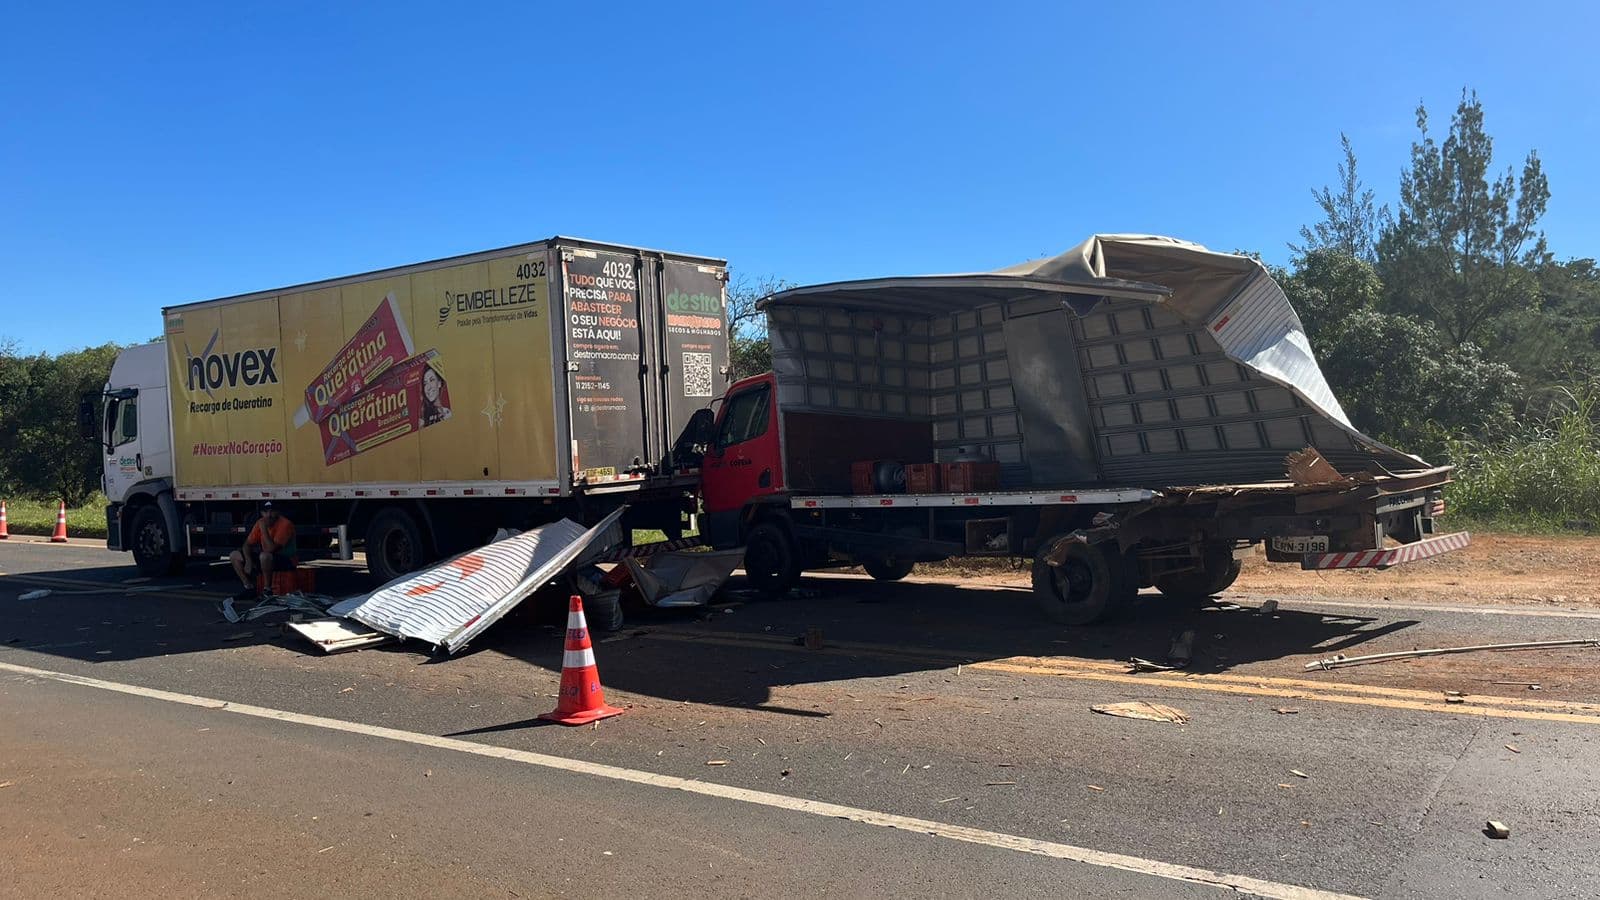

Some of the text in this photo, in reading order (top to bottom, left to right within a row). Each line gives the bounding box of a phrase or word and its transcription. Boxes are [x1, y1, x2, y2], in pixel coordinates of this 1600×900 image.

[516, 261, 546, 280] 4032
[602, 260, 632, 279] 4032
[569, 274, 595, 286] TUDO
[596, 277, 614, 288] QUE
[456, 283, 536, 312] EMBELLEZE
[569, 287, 632, 303] PRECISA PARA
[667, 287, 720, 312] destro
[571, 301, 622, 315] ABASTECER
[571, 314, 638, 329] O SEU NEGÓCIO
[572, 326, 595, 339] ESTÁ
[573, 350, 640, 361] destromacro.com.br
[187, 347, 278, 391] novex
[314, 330, 387, 406] Queratina
[190, 396, 272, 414] Recarga de Queratina
[328, 388, 408, 437] Queratina
[193, 439, 282, 457] #NovexNoCoração
